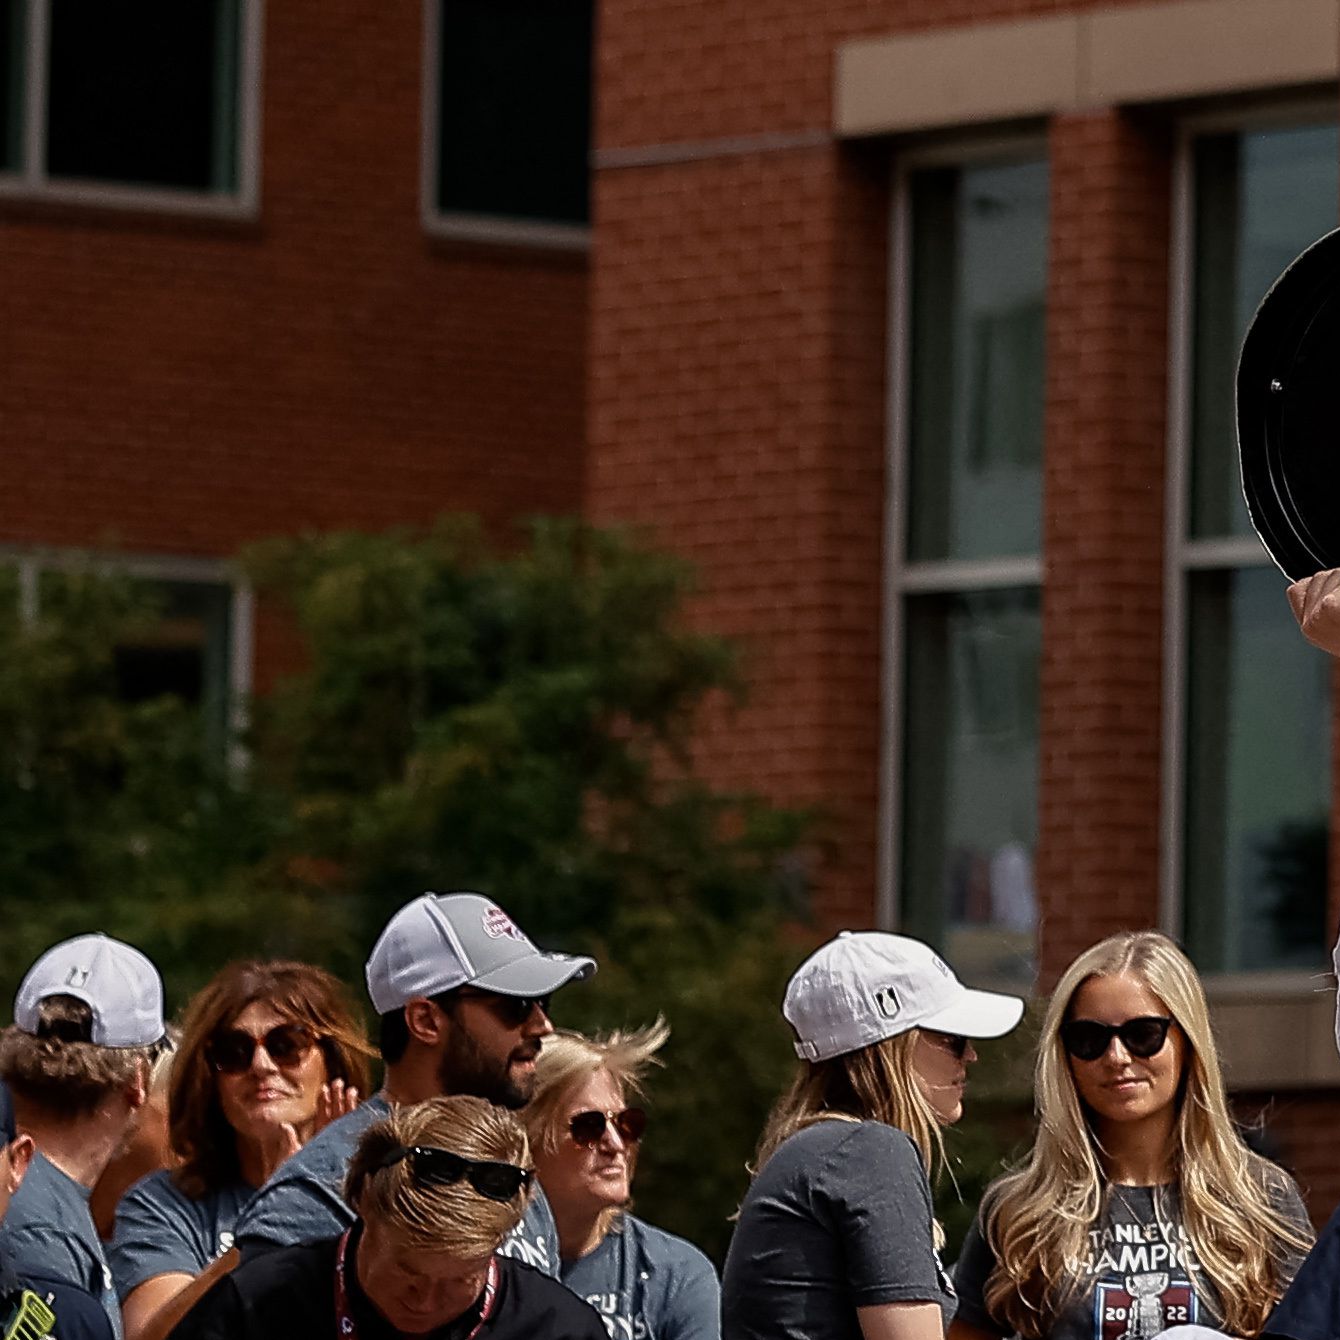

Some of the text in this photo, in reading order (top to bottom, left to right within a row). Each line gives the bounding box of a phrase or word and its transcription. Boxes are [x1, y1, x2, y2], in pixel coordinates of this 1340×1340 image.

[1088, 1222, 1174, 1249] TANLEY
[1105, 1307, 1126, 1321] 20
[1166, 1306, 1187, 1321] 22
